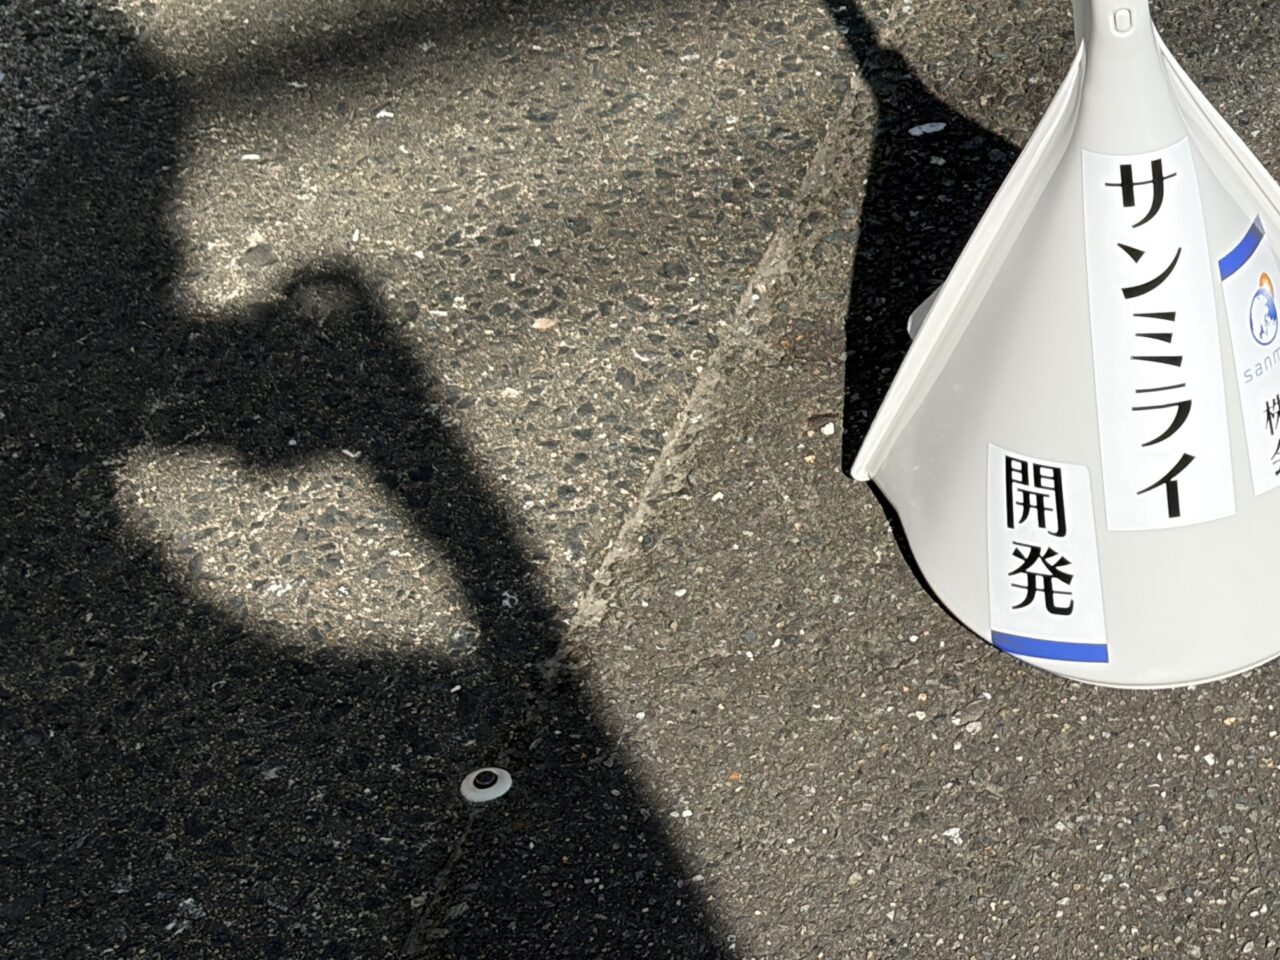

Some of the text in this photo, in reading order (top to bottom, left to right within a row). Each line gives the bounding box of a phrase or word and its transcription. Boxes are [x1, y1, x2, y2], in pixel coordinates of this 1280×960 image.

[1104, 158, 1196, 519] サンミライ
[1004, 455, 1076, 617] 開発
